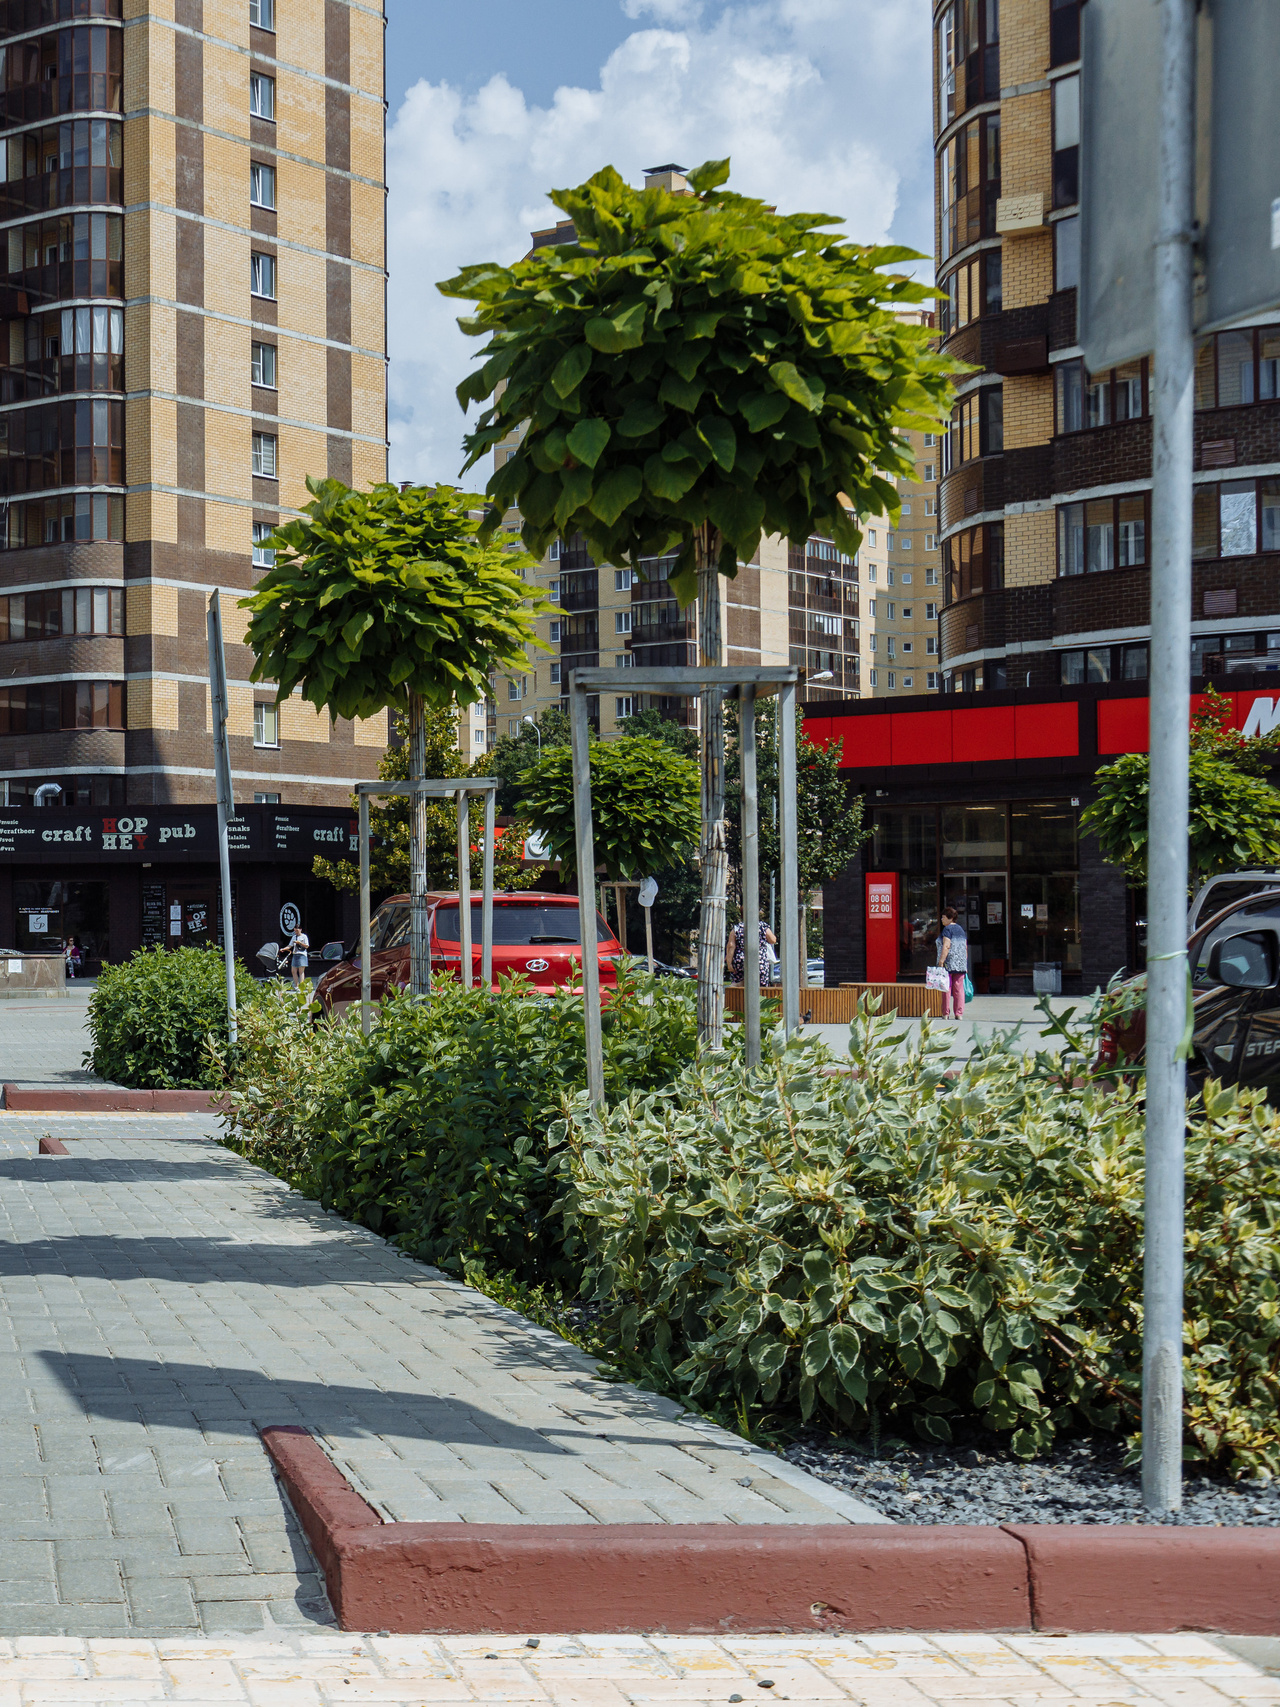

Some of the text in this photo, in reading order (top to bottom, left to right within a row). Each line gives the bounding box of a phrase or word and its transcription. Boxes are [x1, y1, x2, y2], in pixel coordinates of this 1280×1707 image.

[102, 817, 149, 833] HOP
[158, 823, 196, 843] pub
[41, 825, 92, 842] craft
[313, 826, 344, 842] craft
[102, 834, 149, 850] HEY
